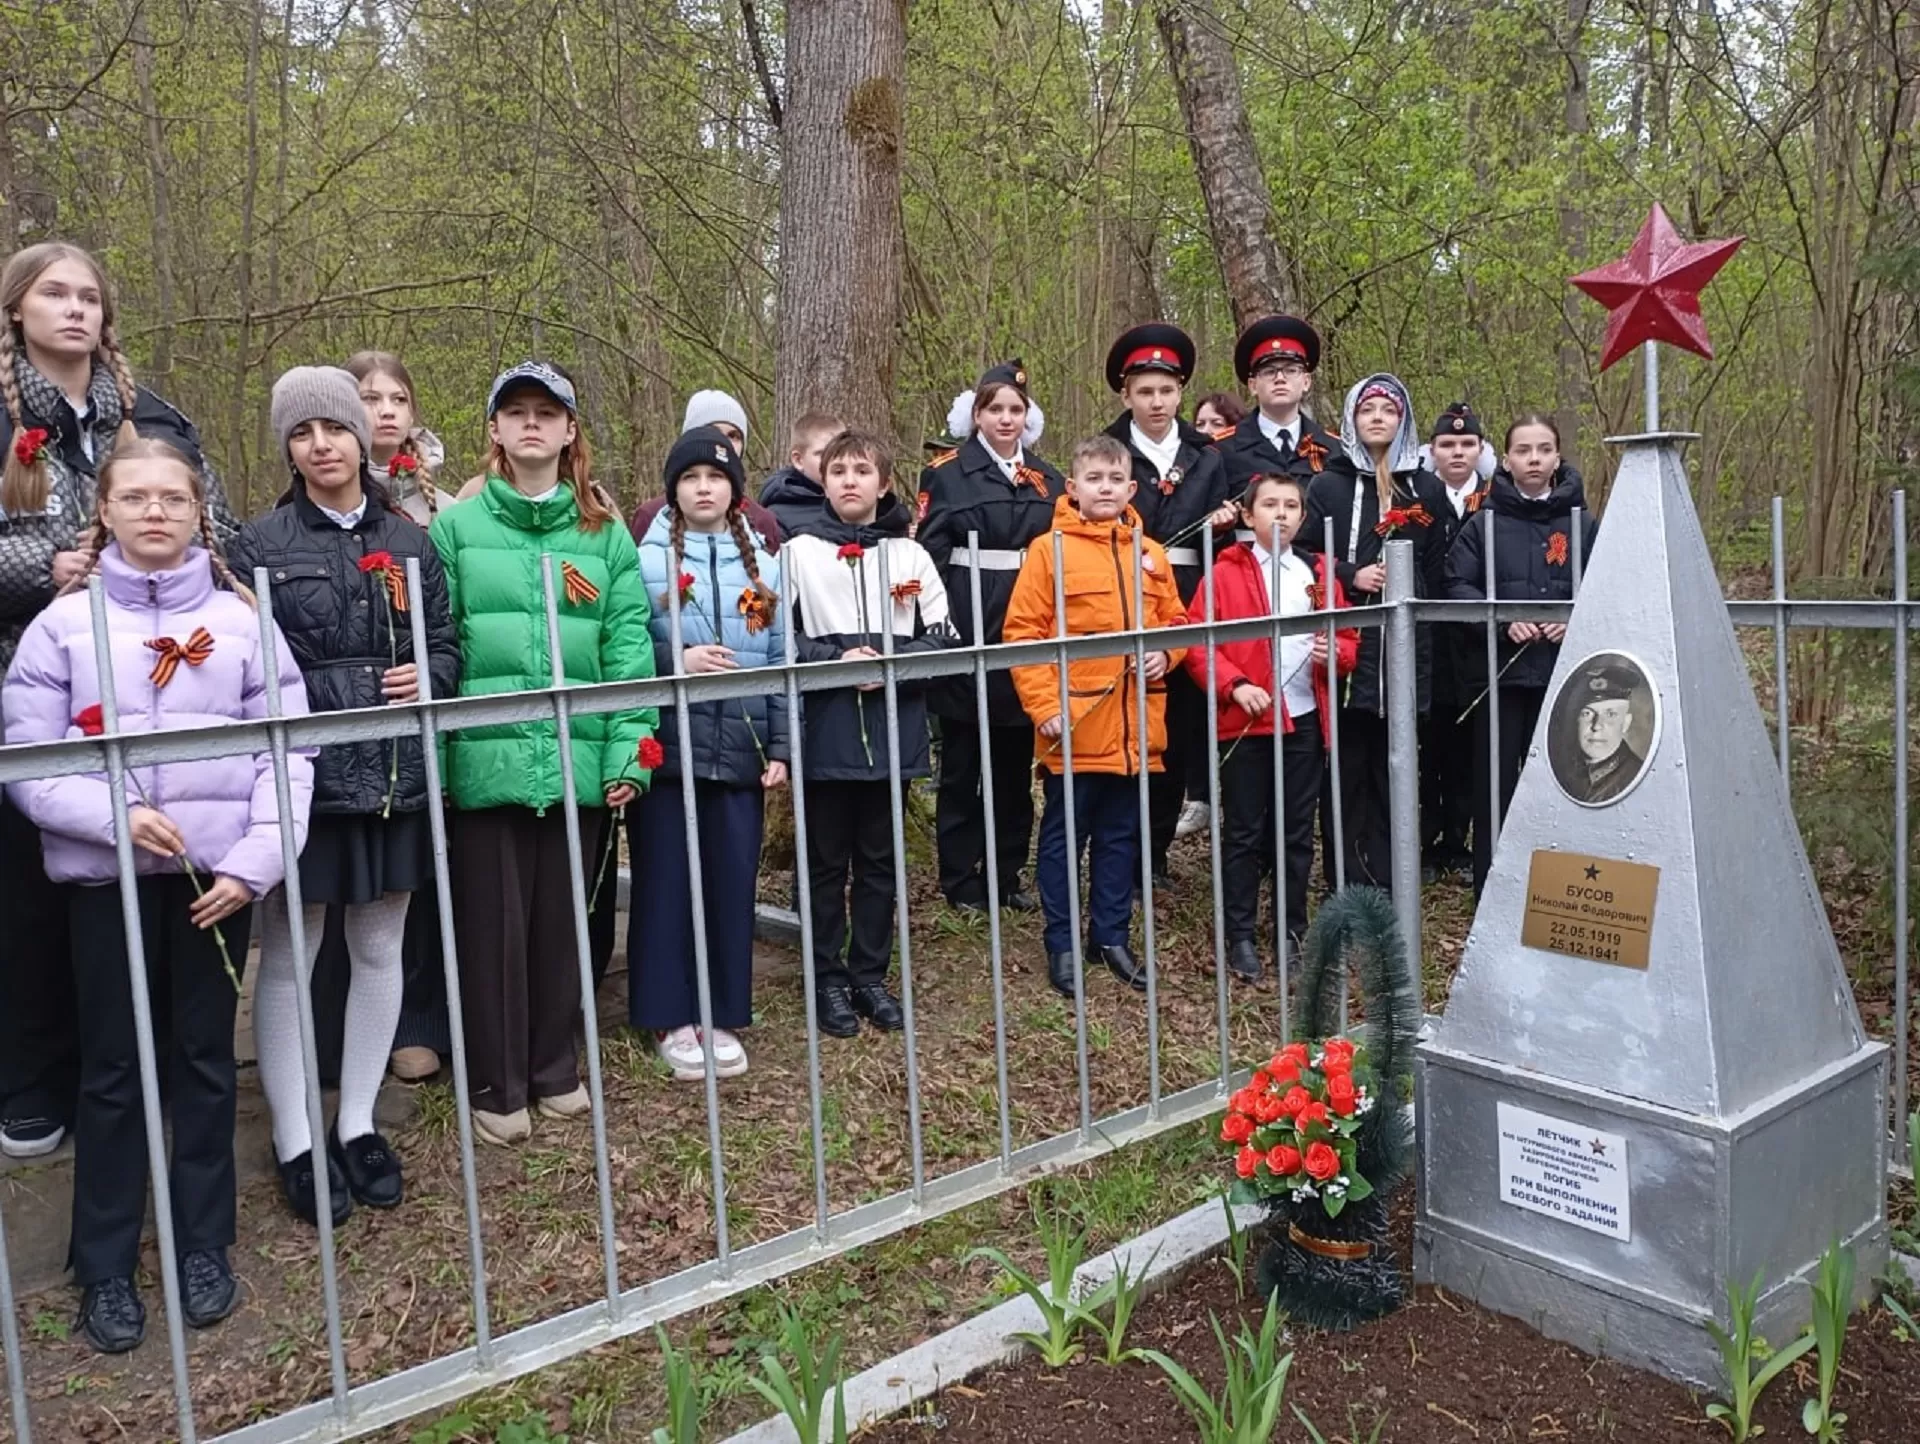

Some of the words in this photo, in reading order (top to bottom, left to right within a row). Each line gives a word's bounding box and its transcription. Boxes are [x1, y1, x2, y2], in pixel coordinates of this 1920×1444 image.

[1566, 885, 1614, 903] БУСОВ
[1532, 894, 1579, 911] Николай
[1581, 903, 1647, 924] Федорович
[1550, 922, 1621, 946] 22.05.1919
[1549, 937, 1620, 961] 25.12.1941
[1543, 1171, 1582, 1190] ПОГИБ
[1511, 1175, 1533, 1189] ПРИ
[1536, 1182, 1618, 1216] ВЫПОЛНЕНИИ
[1510, 1188, 1561, 1211] БОЕВОГО
[1564, 1205, 1619, 1230] ЗАДАНИЯ
